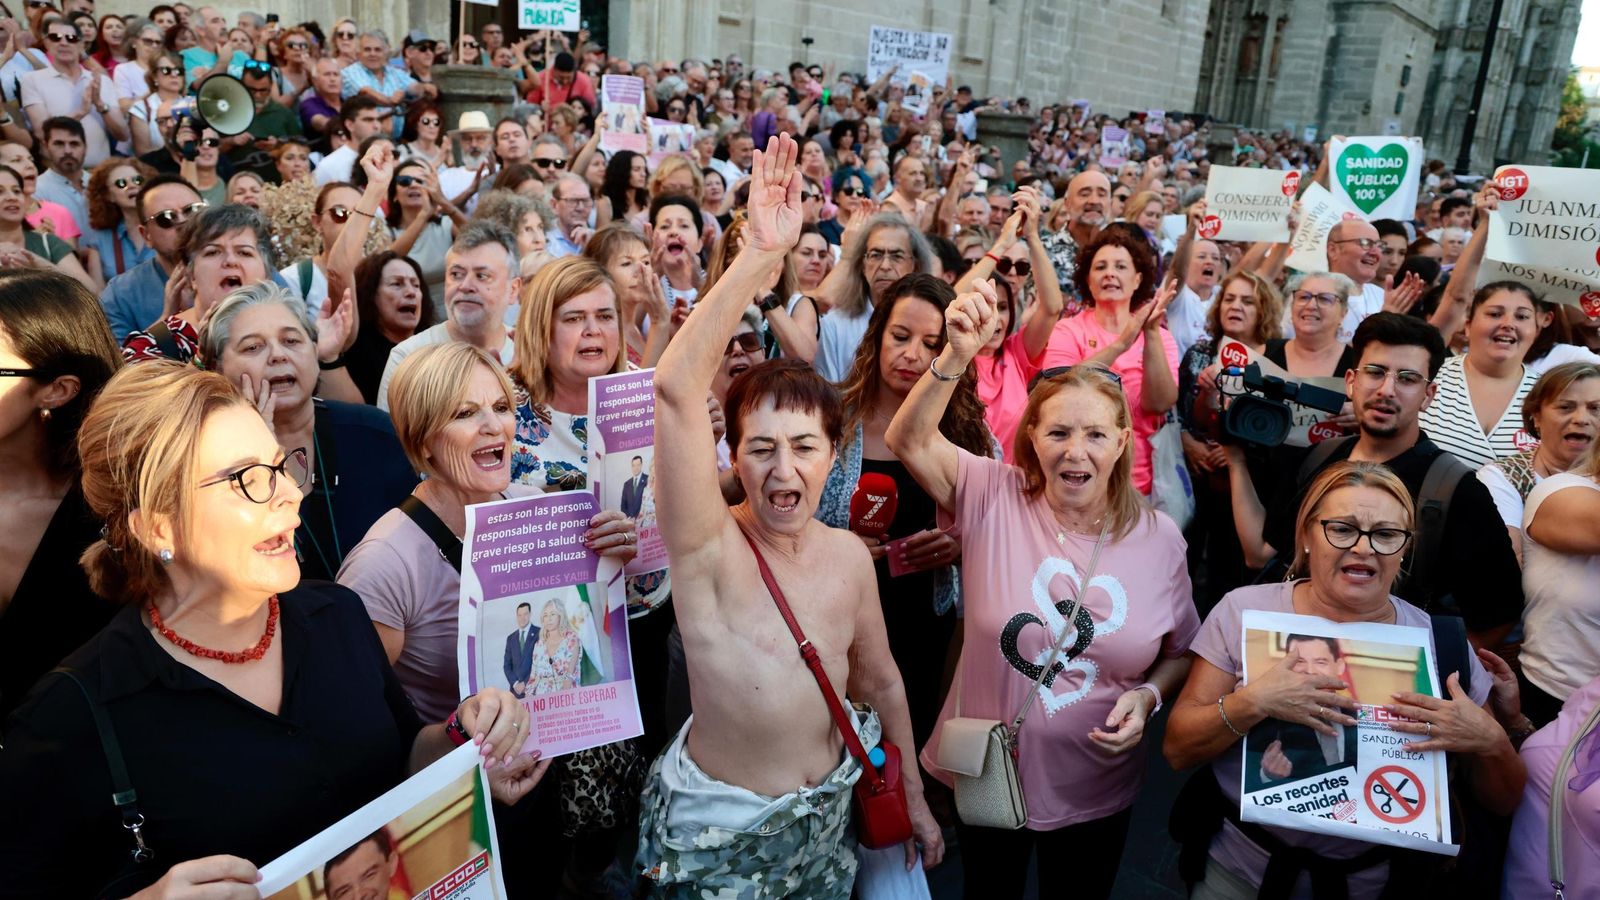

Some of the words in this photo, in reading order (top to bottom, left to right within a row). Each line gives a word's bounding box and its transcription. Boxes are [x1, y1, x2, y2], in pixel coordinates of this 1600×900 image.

[1345, 157, 1404, 169] SANIDAD
[1283, 176, 1298, 187] UGT
[1345, 171, 1399, 186] PÚBLICA
[1214, 192, 1290, 207] CONSEJERA
[1355, 188, 1376, 200] 100
[1377, 188, 1386, 200] %
[1218, 208, 1281, 222] DIMISIÓN
[1199, 219, 1219, 232] UGT
[1508, 221, 1600, 242] DIMISIÓ
[1499, 262, 1536, 280] NOS
[1540, 272, 1592, 292] MATA
[1223, 347, 1248, 365] UGT
[605, 383, 626, 394] estas
[627, 381, 642, 390] son
[642, 378, 654, 388] las
[599, 393, 652, 409] responsables
[596, 412, 620, 425] grave
[621, 407, 645, 418] riesgo
[646, 405, 654, 414] la
[612, 421, 644, 433] mujeres
[1311, 426, 1343, 440] UGT
[487, 510, 513, 525] estas
[515, 508, 533, 519] son
[534, 505, 549, 517] las
[551, 500, 593, 517] personas
[863, 493, 888, 521] 7
[476, 524, 543, 543] responsables
[545, 519, 558, 531] de
[560, 517, 590, 533] poner
[859, 520, 884, 529] siete
[471, 547, 502, 563] grave
[503, 540, 535, 555] riesgo
[537, 538, 546, 549] la
[548, 533, 576, 547] salud
[490, 557, 533, 574] mujeres
[535, 549, 587, 566] andaluzas
[500, 575, 561, 594] DIMISIONES
[533, 698, 546, 713] NO
[548, 694, 577, 710] PUEDE
[579, 686, 617, 705] ESPERAR
[1361, 734, 1411, 745] SANIDAD
[1381, 747, 1425, 761] PÚBLICA
[1252, 793, 1283, 807] Los
[1285, 775, 1350, 800] recortes
[1287, 788, 1349, 814] sanidad
[433, 863, 476, 898] CCOO
